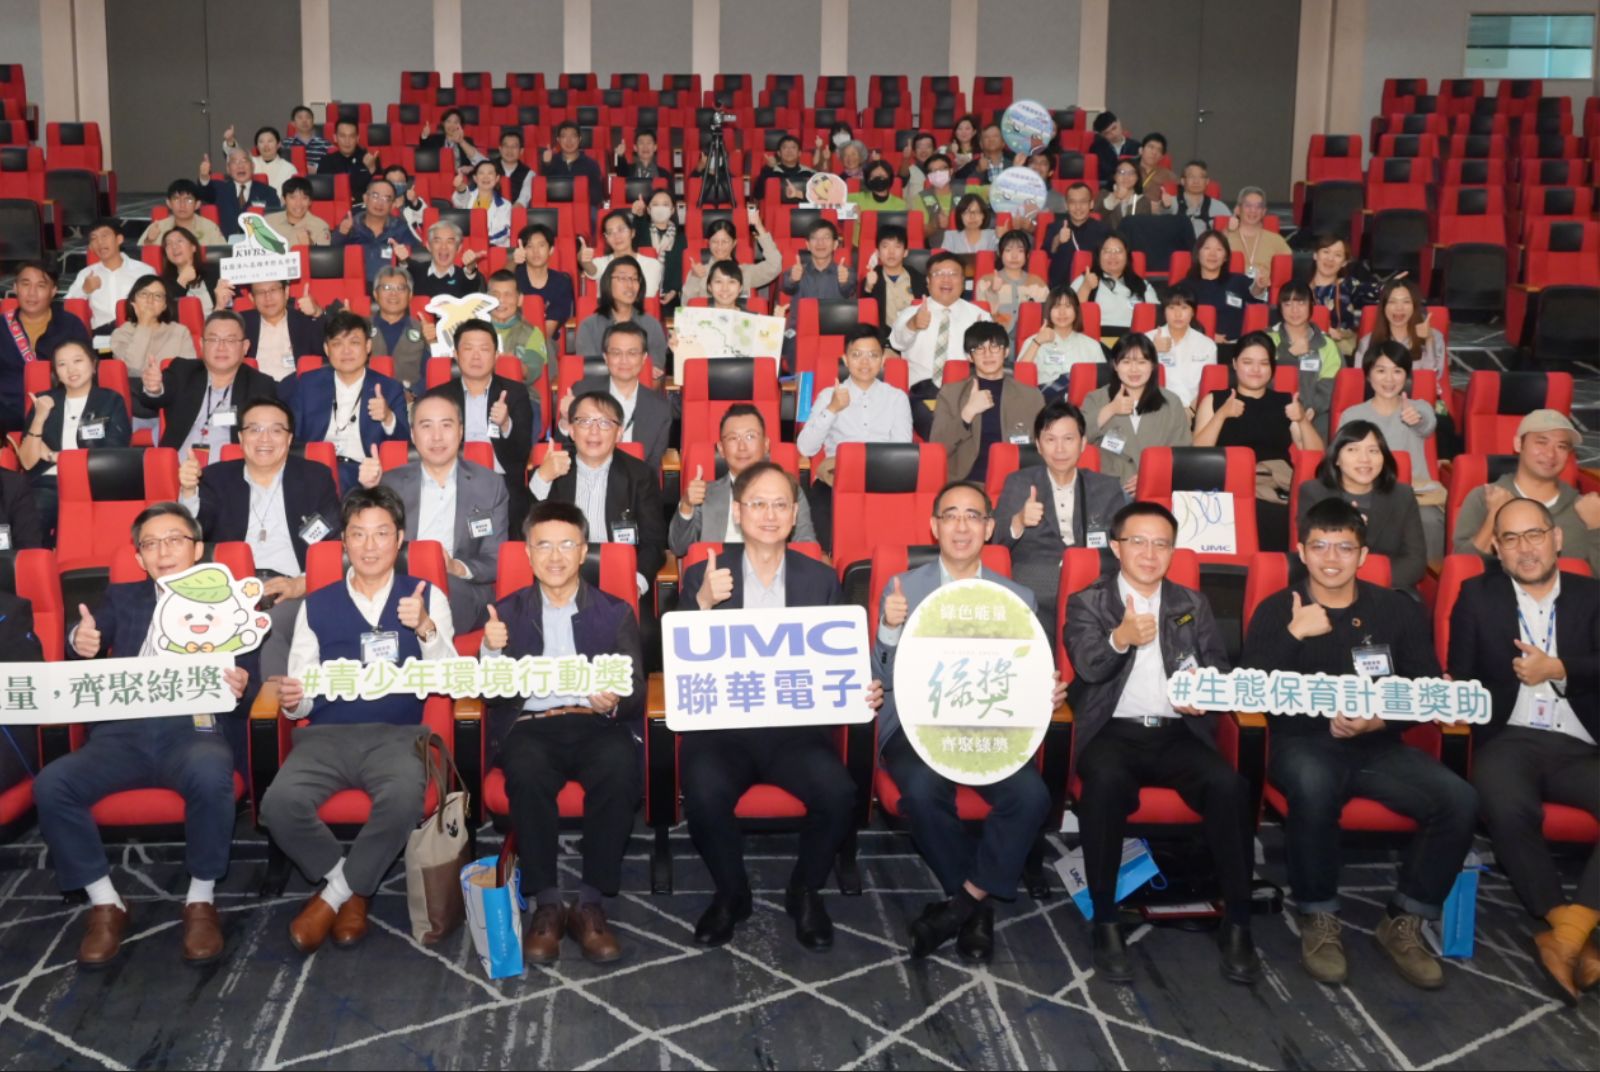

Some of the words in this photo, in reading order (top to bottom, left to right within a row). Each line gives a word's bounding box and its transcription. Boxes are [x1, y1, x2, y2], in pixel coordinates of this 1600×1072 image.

[673, 620, 858, 662] UMC
[0, 664, 222, 711] 量，齊聚綠獎
[302, 660, 629, 697] #青少年環境行動獎
[676, 669, 862, 715] 聯華電子
[1172, 672, 1489, 719] #生態保育計畫獎助
